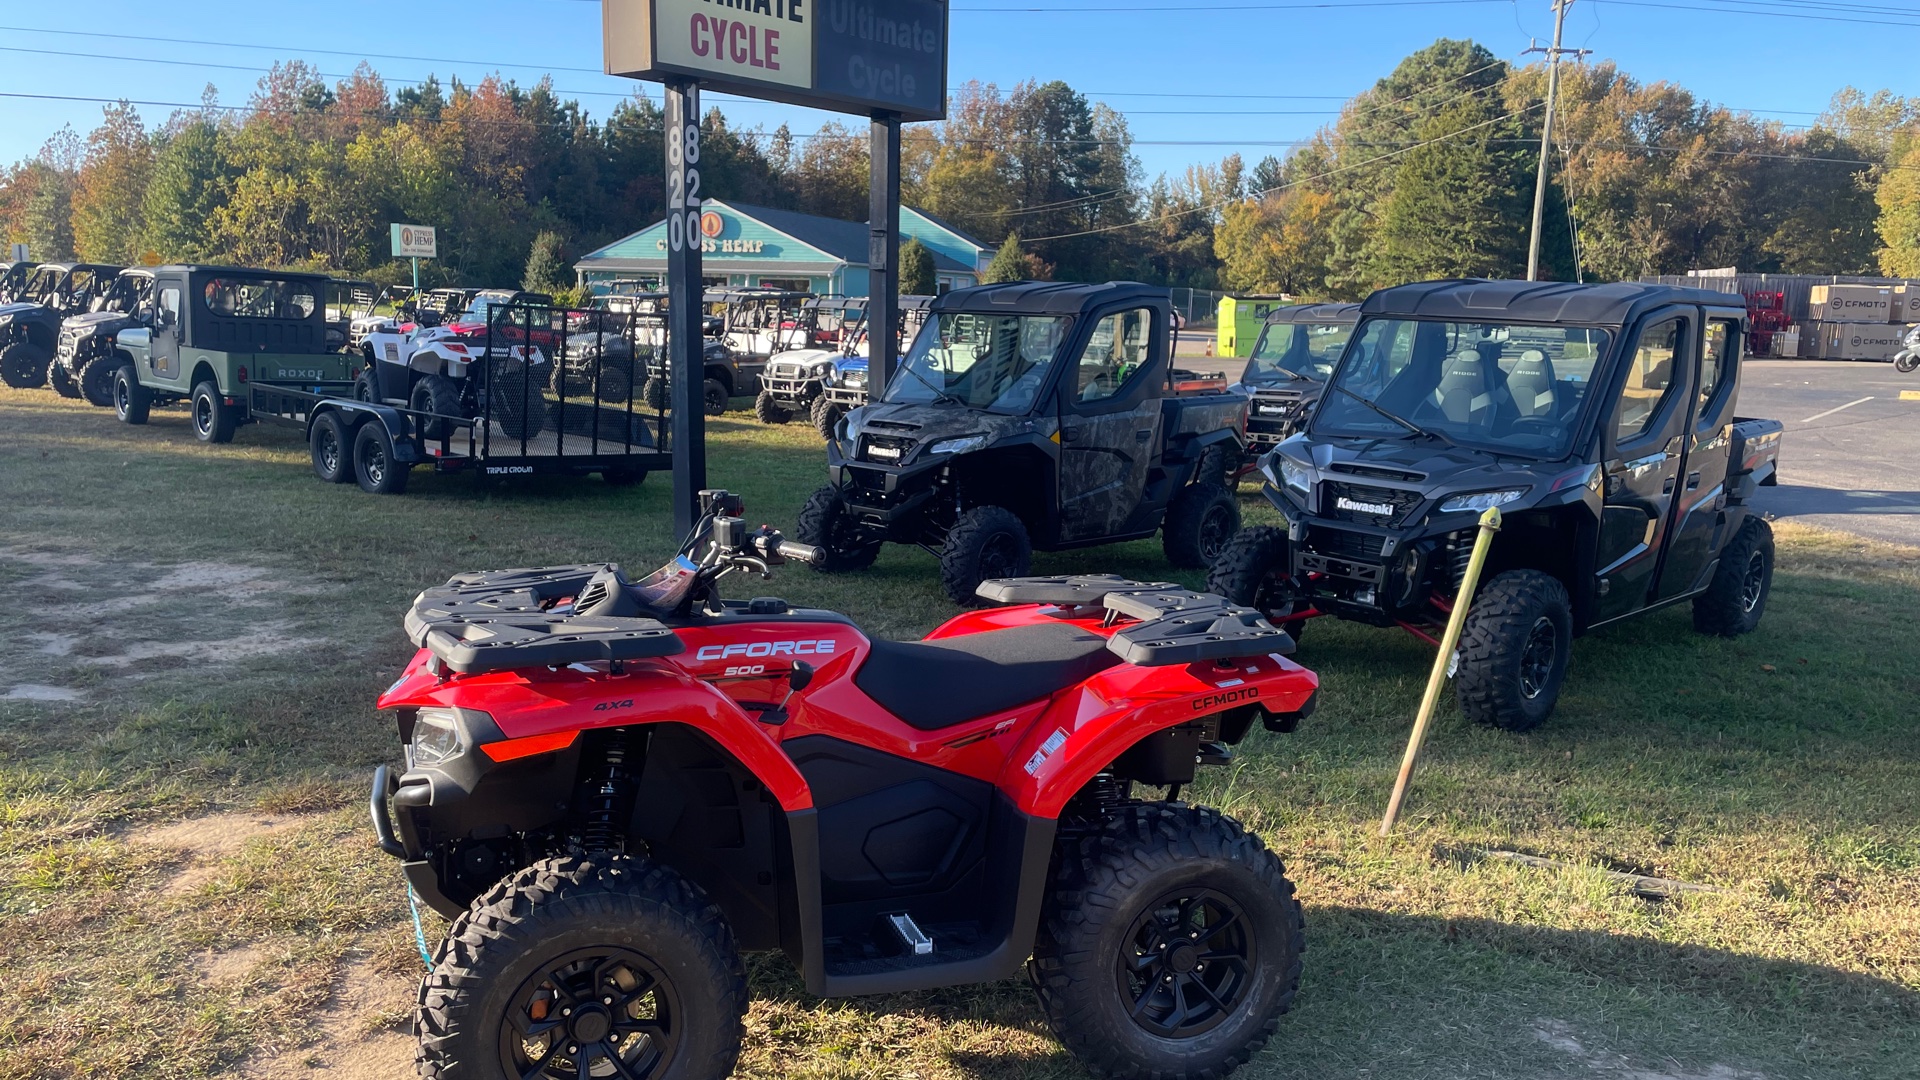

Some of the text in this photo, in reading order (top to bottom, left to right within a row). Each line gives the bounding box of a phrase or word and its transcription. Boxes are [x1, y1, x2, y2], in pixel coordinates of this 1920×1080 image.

[830, 0, 936, 53] Ultimate
[690, 12, 780, 71] CYCLE
[847, 54, 917, 99] Cycle
[684, 83, 701, 250] 1820
[415, 237, 434, 246] HEMP
[722, 239, 764, 253] HEMP
[1863, 338, 1900, 346] CFMOTO
[868, 444, 900, 458] Kawasaki
[509, 466, 532, 474] CROWN
[1337, 497, 1394, 516] Kawasaki
[696, 640, 836, 661] CFORCE
[724, 665, 764, 676] 500
[1192, 687, 1259, 710] CFMOTO
